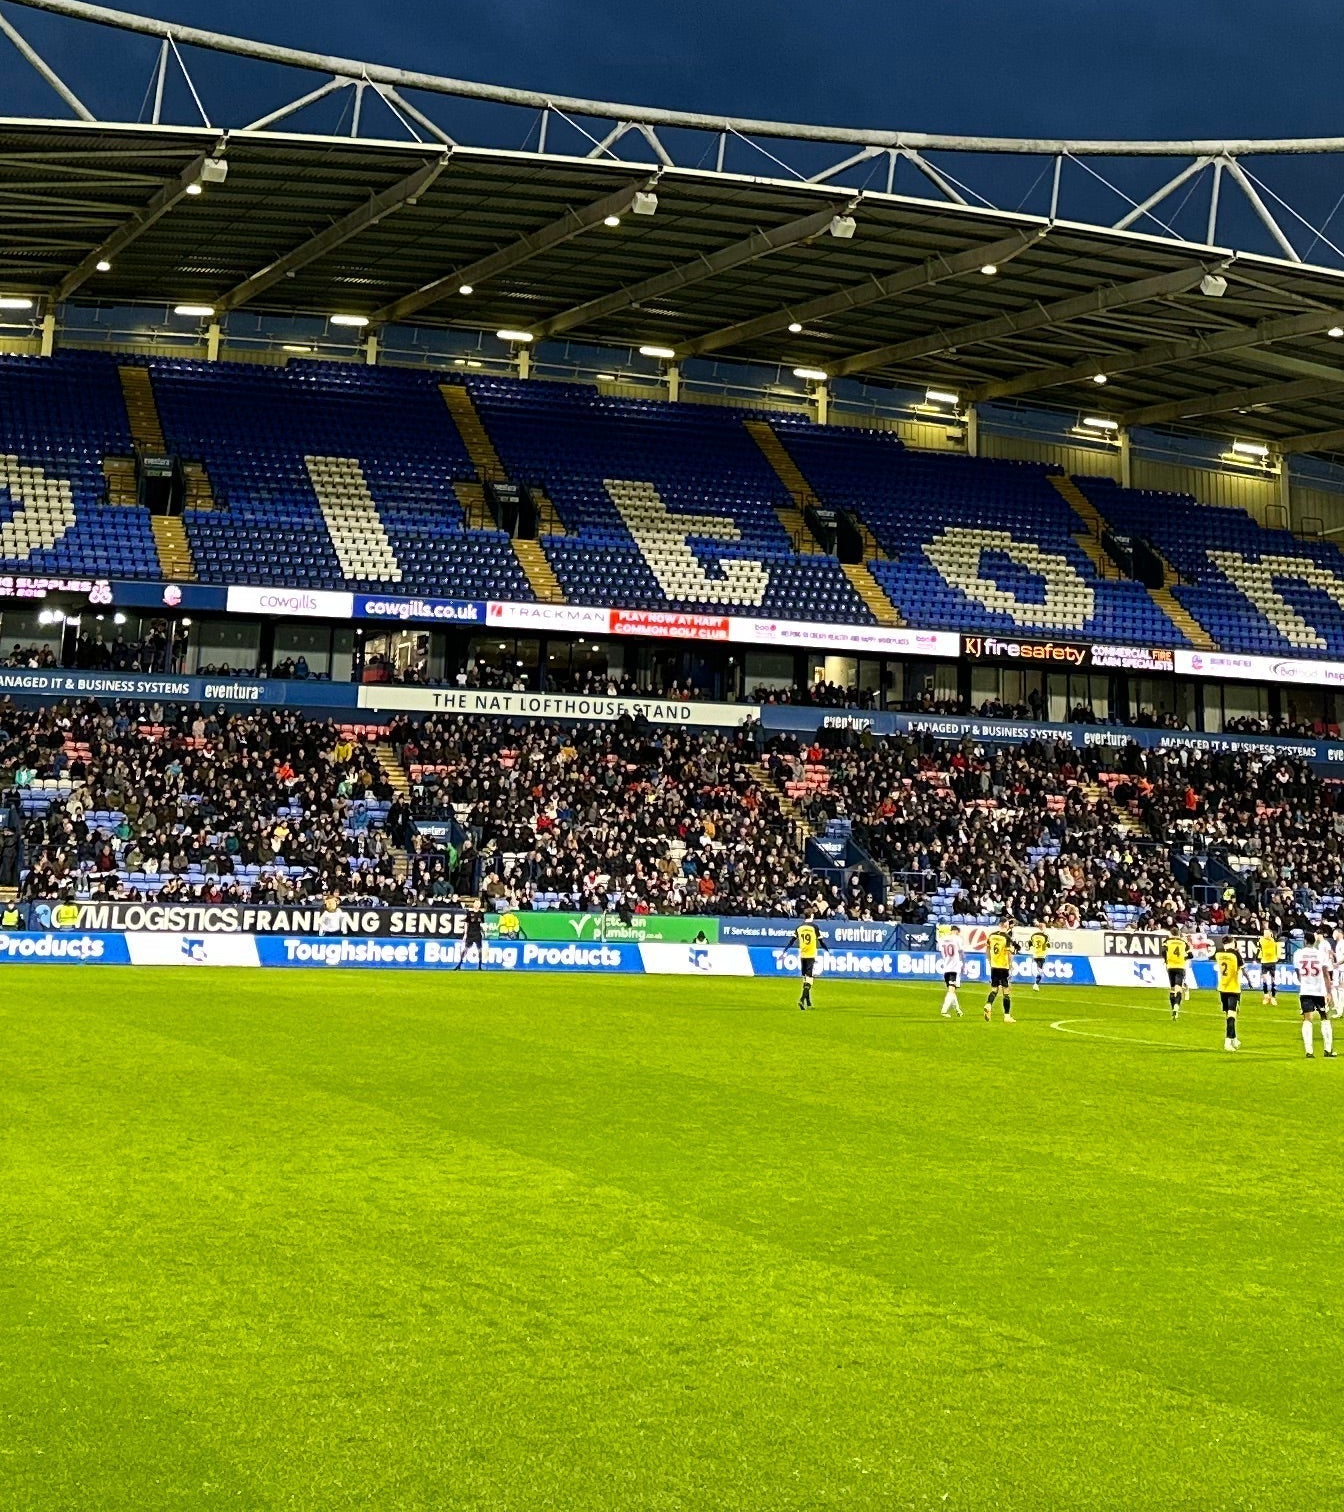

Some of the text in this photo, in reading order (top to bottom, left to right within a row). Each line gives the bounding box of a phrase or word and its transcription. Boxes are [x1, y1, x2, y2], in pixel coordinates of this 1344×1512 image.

[16, 578, 92, 592] SUPPLIES
[259, 593, 317, 612] cowgills
[365, 599, 477, 620] cowgills.co.uk
[509, 606, 605, 622] TRACKMAN
[618, 611, 724, 627] PLAY NOW AT HART
[614, 623, 729, 638] COMMON GOLF CLUB
[965, 638, 1085, 665] KJ firesafety
[1091, 645, 1172, 661] COMMERCIAL FIRE
[1091, 655, 1173, 671] ALARM SPECIALISTS
[51, 676, 63, 690] IT
[65, 678, 76, 691] &
[78, 679, 134, 693] BUSINESS
[137, 681, 190, 695] SYSTEMS
[205, 683, 258, 700] eventura
[433, 693, 692, 720] THE NAT LOFTHOUSE STAND
[960, 724, 970, 735] IT
[972, 725, 981, 736] &
[982, 726, 1028, 739] BUSINESS
[1030, 729, 1073, 741] SYSTEMS
[112, 907, 240, 932] LOGISTICS
[390, 912, 467, 934] SENSE
[724, 926, 767, 936] IT Services &
[800, 933, 812, 945] 19
[835, 926, 883, 942] eventura
[284, 939, 622, 968] Toughsheet Building Products
[940, 944, 955, 957] 10
[1172, 945, 1181, 958] 4
[1221, 961, 1229, 977] 2
[1298, 960, 1321, 977] 35
